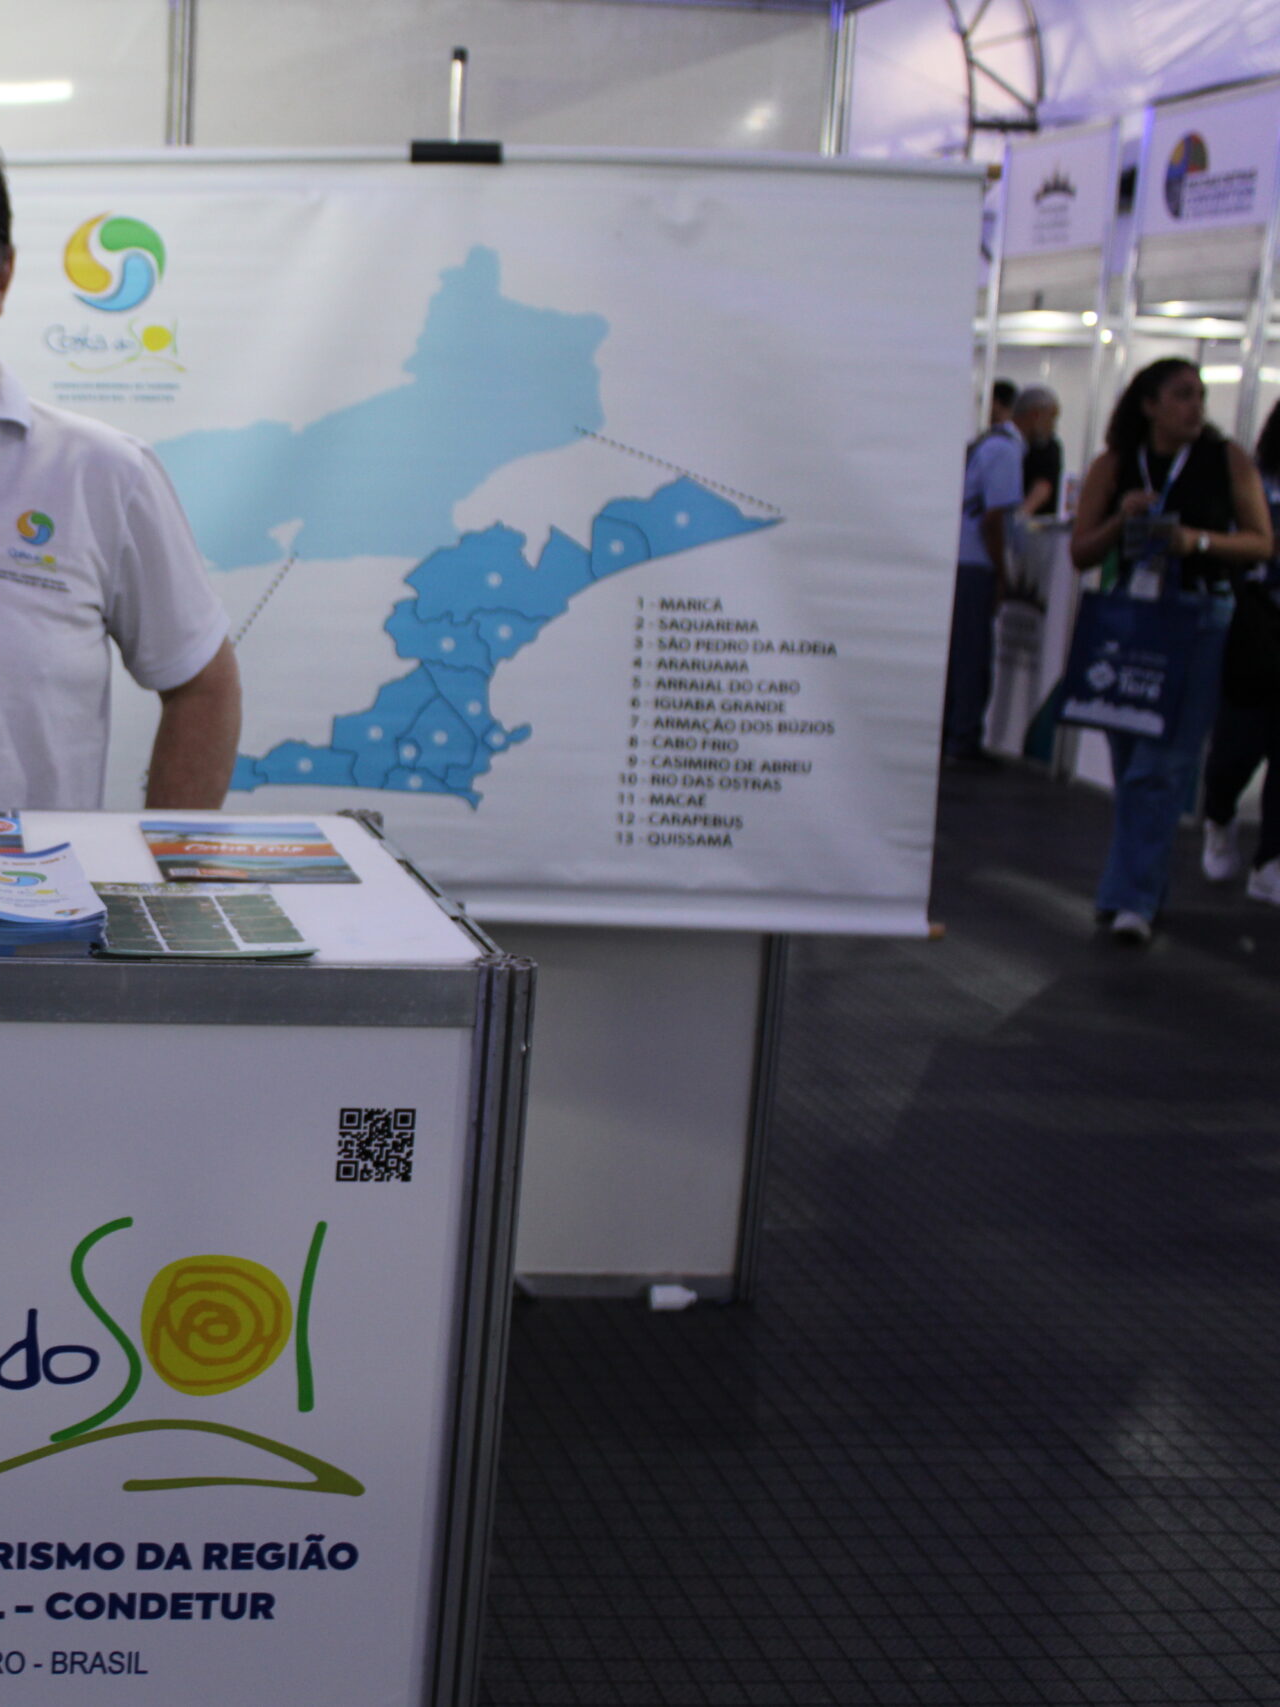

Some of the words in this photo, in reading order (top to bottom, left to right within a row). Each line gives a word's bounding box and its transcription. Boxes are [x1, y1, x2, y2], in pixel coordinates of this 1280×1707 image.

[658, 617, 760, 634] SAQUAREMA
[695, 638, 749, 654] PEDRO
[752, 639, 775, 654] DA
[779, 640, 838, 657] ALDEIA
[656, 655, 749, 673] ARARUAMA
[655, 676, 724, 692] ARRAIAL
[729, 678, 753, 693] DO
[757, 679, 801, 695] CABO
[654, 696, 716, 712] IGUABA
[721, 698, 786, 714] GRANDE
[740, 718, 773, 734] DOS
[652, 735, 698, 751] CABO
[701, 737, 740, 753] FRIO
[650, 754, 730, 772] CASIMIRO
[734, 758, 756, 773] DE
[760, 758, 812, 775] ABREU
[619, 772, 638, 786] 10
[650, 772, 678, 787] RIO
[682, 774, 715, 789] DAS
[719, 776, 783, 792] OSTRAS
[618, 792, 635, 806] 11
[617, 811, 635, 825] 12
[648, 811, 744, 830] CARAPEBUS
[616, 831, 634, 845] 13
[135, 1541, 193, 1571] DA
[202, 1533, 360, 1571] REGIÃO
[45, 1592, 277, 1621] CONDETUR
[51, 1650, 149, 1675] BRASIL
